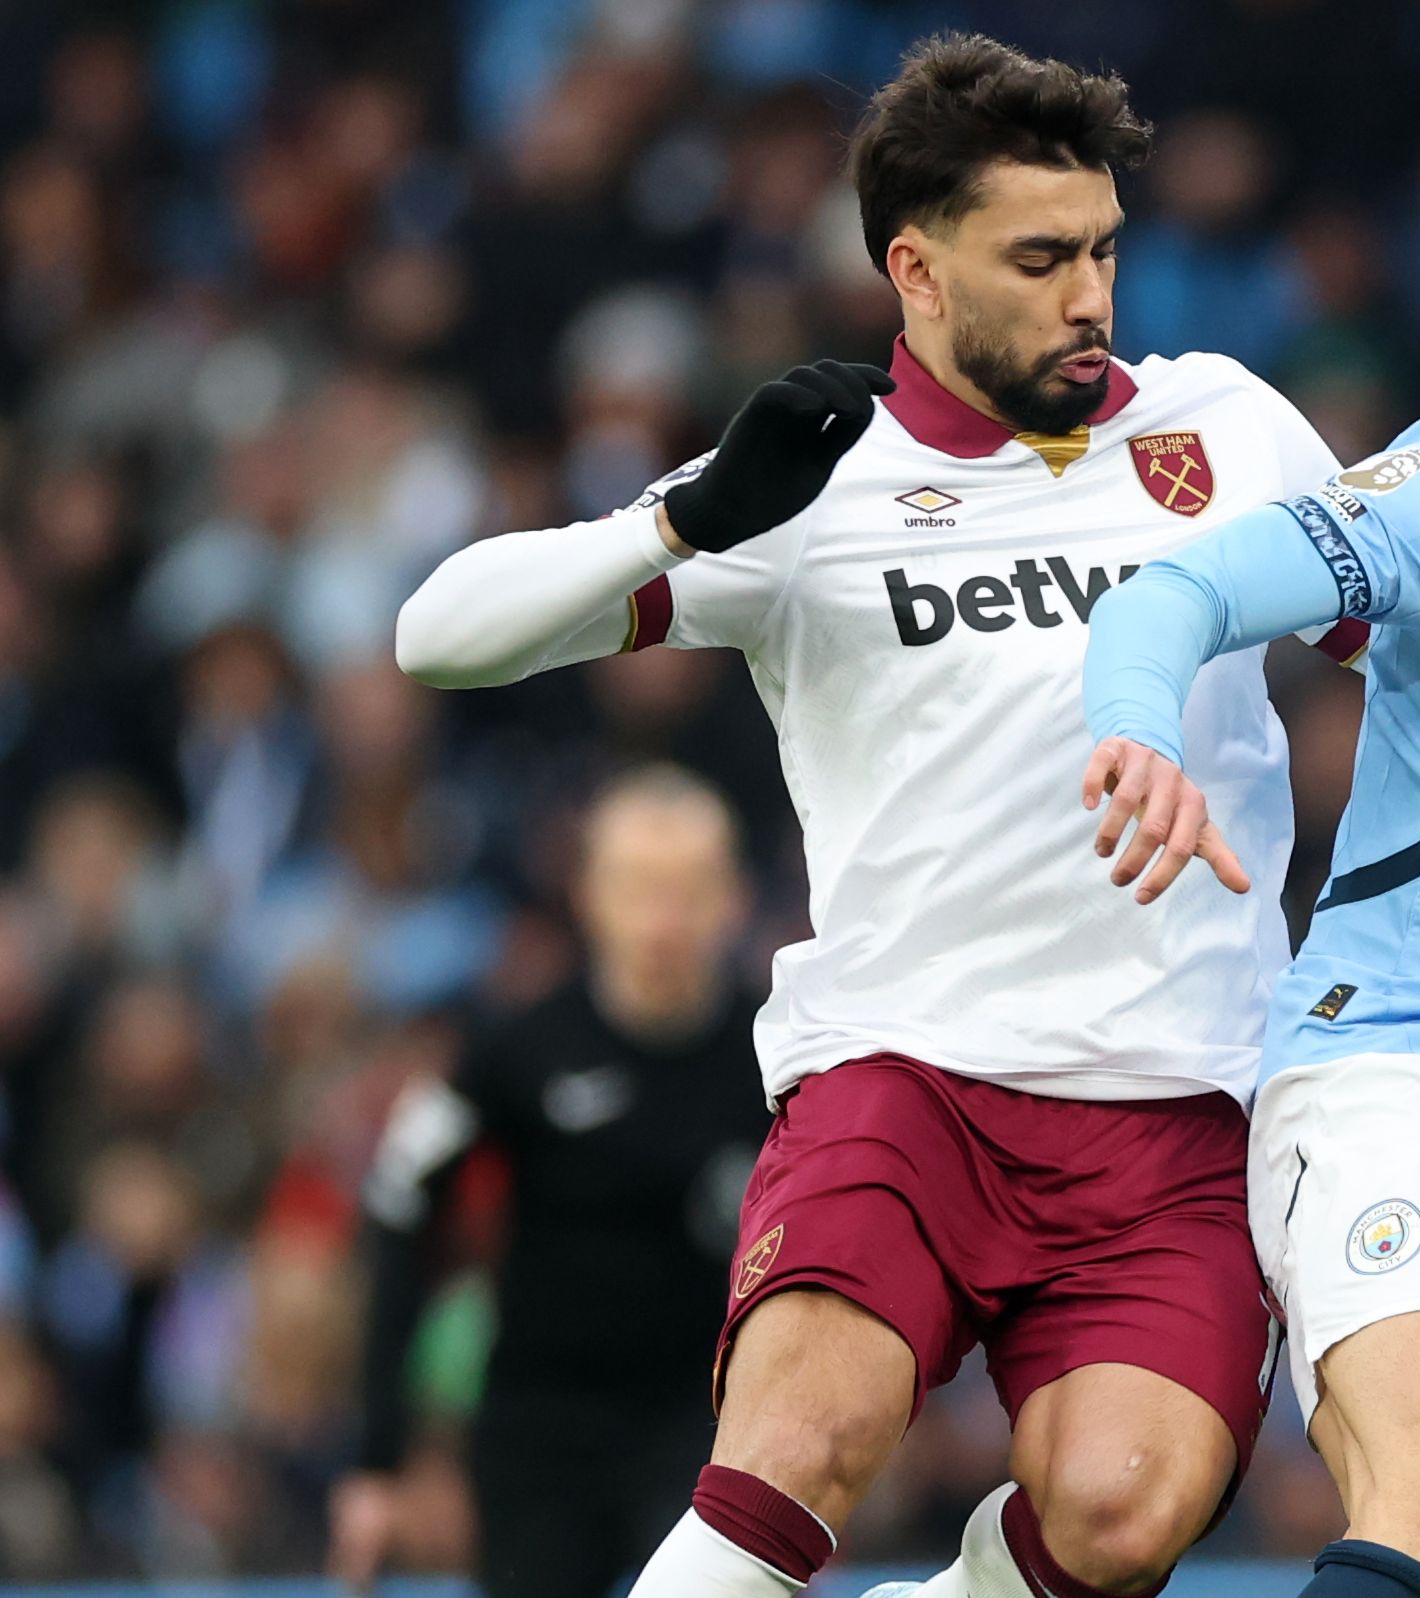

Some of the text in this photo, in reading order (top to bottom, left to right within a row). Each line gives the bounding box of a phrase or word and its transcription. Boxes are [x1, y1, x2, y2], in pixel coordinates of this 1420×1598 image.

[1134, 435, 1195, 451] WEST HAM
[904, 516, 956, 528] umbro
[1352, 1204, 1413, 1244] MANCHESTER
[1378, 1255, 1401, 1270] CITY
